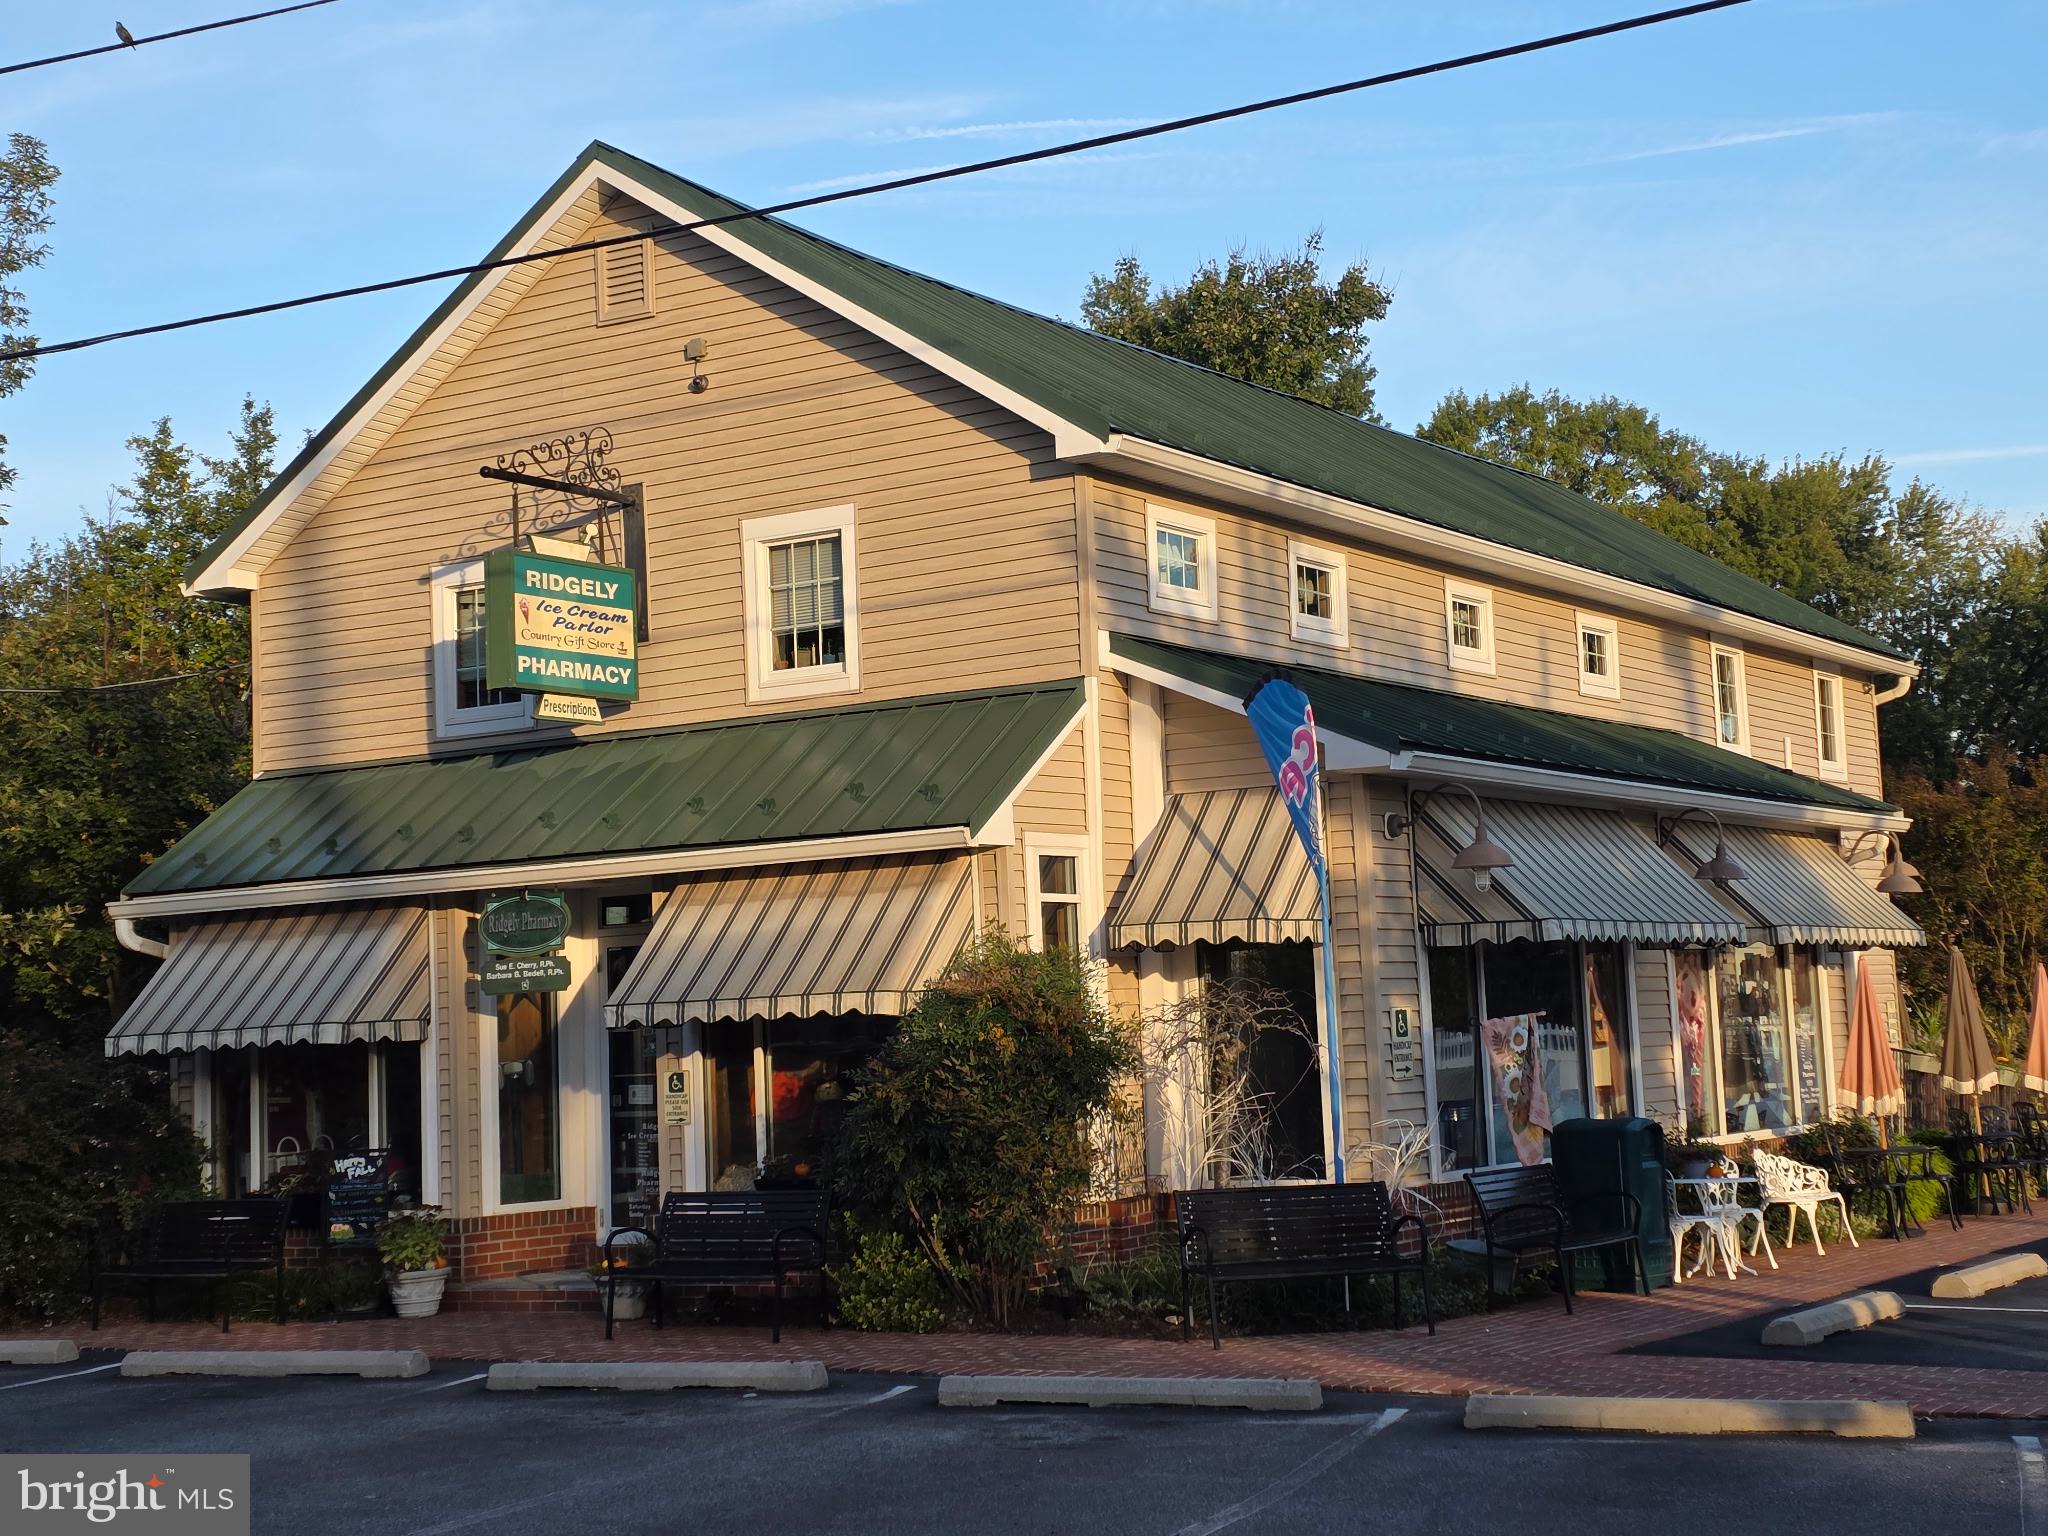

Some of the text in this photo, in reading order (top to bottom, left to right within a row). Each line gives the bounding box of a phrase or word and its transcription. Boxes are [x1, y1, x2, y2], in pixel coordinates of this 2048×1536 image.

[526, 570, 618, 600] RIDGELY
[536, 600, 629, 624] Ice Cream
[552, 616, 613, 635] Parlor
[521, 628, 616, 650] Country Gift Store
[518, 655, 631, 685] PHARMACY
[543, 698, 597, 717] Prescriptions
[488, 911, 563, 938] Ridgely Pharmacy
[486, 972, 512, 980] Barbara
[523, 970, 546, 978] Bedell,
[495, 963, 507, 971] Sue
[516, 962, 539, 970] Cherry,
[1393, 1041, 1413, 1050] HANDICAP
[347, 1165, 377, 1180] FALL
